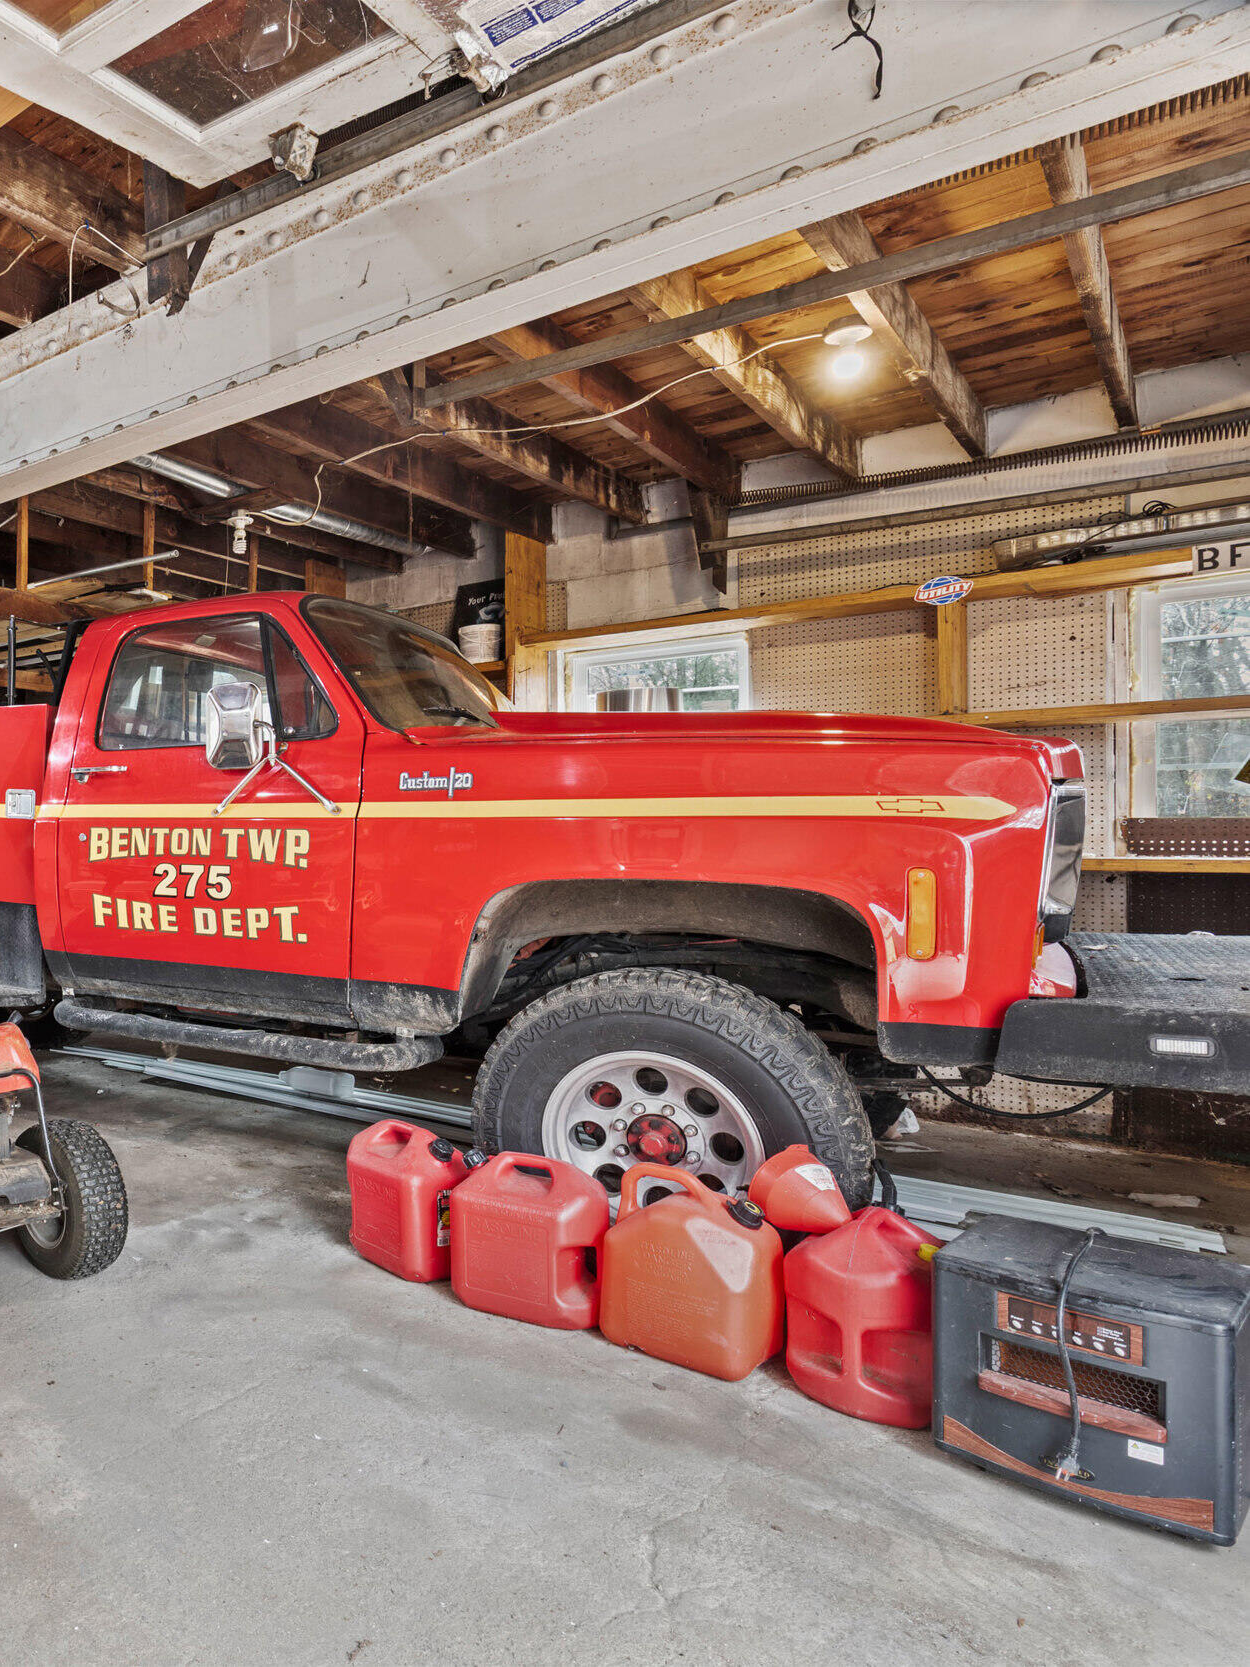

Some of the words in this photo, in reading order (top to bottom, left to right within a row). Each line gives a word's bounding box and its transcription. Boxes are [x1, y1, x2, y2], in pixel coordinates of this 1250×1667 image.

[917, 582, 971, 600] UTILITY
[399, 770, 448, 791] Custom
[454, 772, 473, 790] 20
[89, 826, 212, 862] BENTON
[221, 828, 310, 869] TWP.
[152, 862, 232, 900] 275
[93, 893, 179, 932] FIRE
[193, 905, 308, 943] DEPT.
